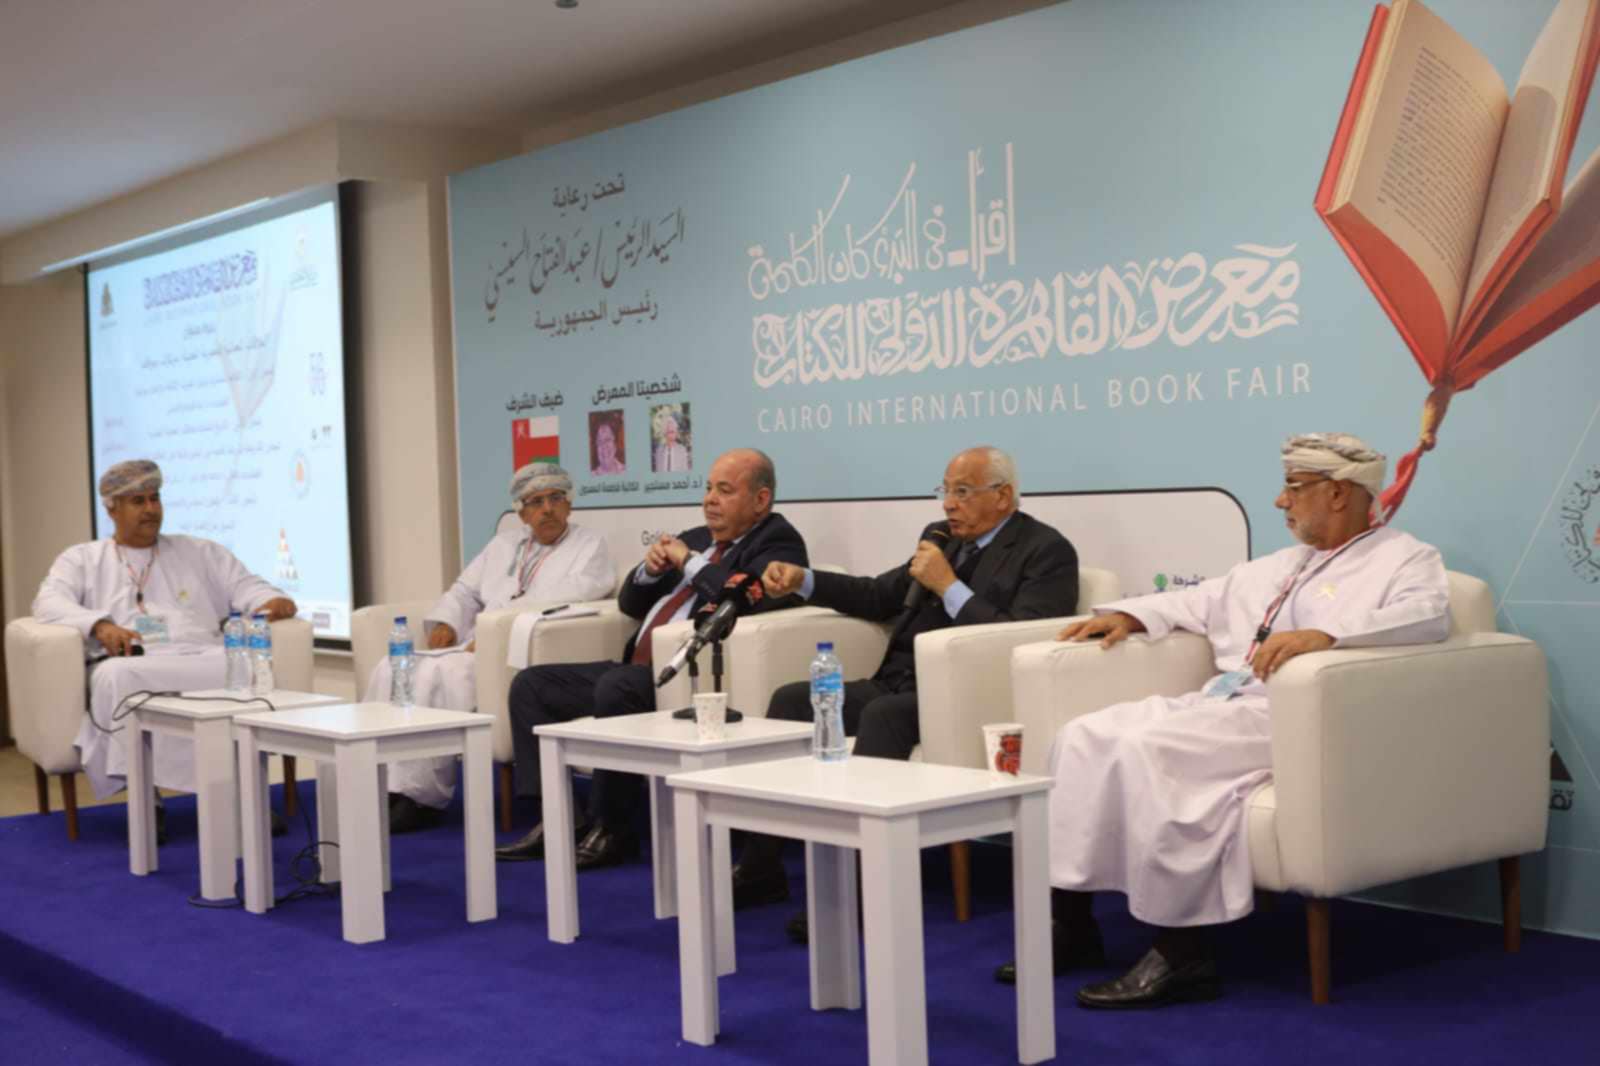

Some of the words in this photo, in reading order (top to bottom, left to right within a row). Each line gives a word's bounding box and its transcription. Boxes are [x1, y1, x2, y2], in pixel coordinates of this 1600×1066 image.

[551, 184, 589, 218] رعاية
[591, 172, 626, 201] تحت
[646, 205, 685, 265] السيد
[534, 299, 608, 338] الجمهورية
[611, 289, 659, 325] رئيس
[505, 391, 537, 413] الشرف
[591, 381, 636, 406] المعرض
[635, 372, 682, 400] شخصيتا
[757, 402, 833, 433] CAIRO
[846, 382, 1089, 427] INTERNATIONAL
[1107, 371, 1204, 409] BOOK
[1225, 362, 1312, 400] FAIR
